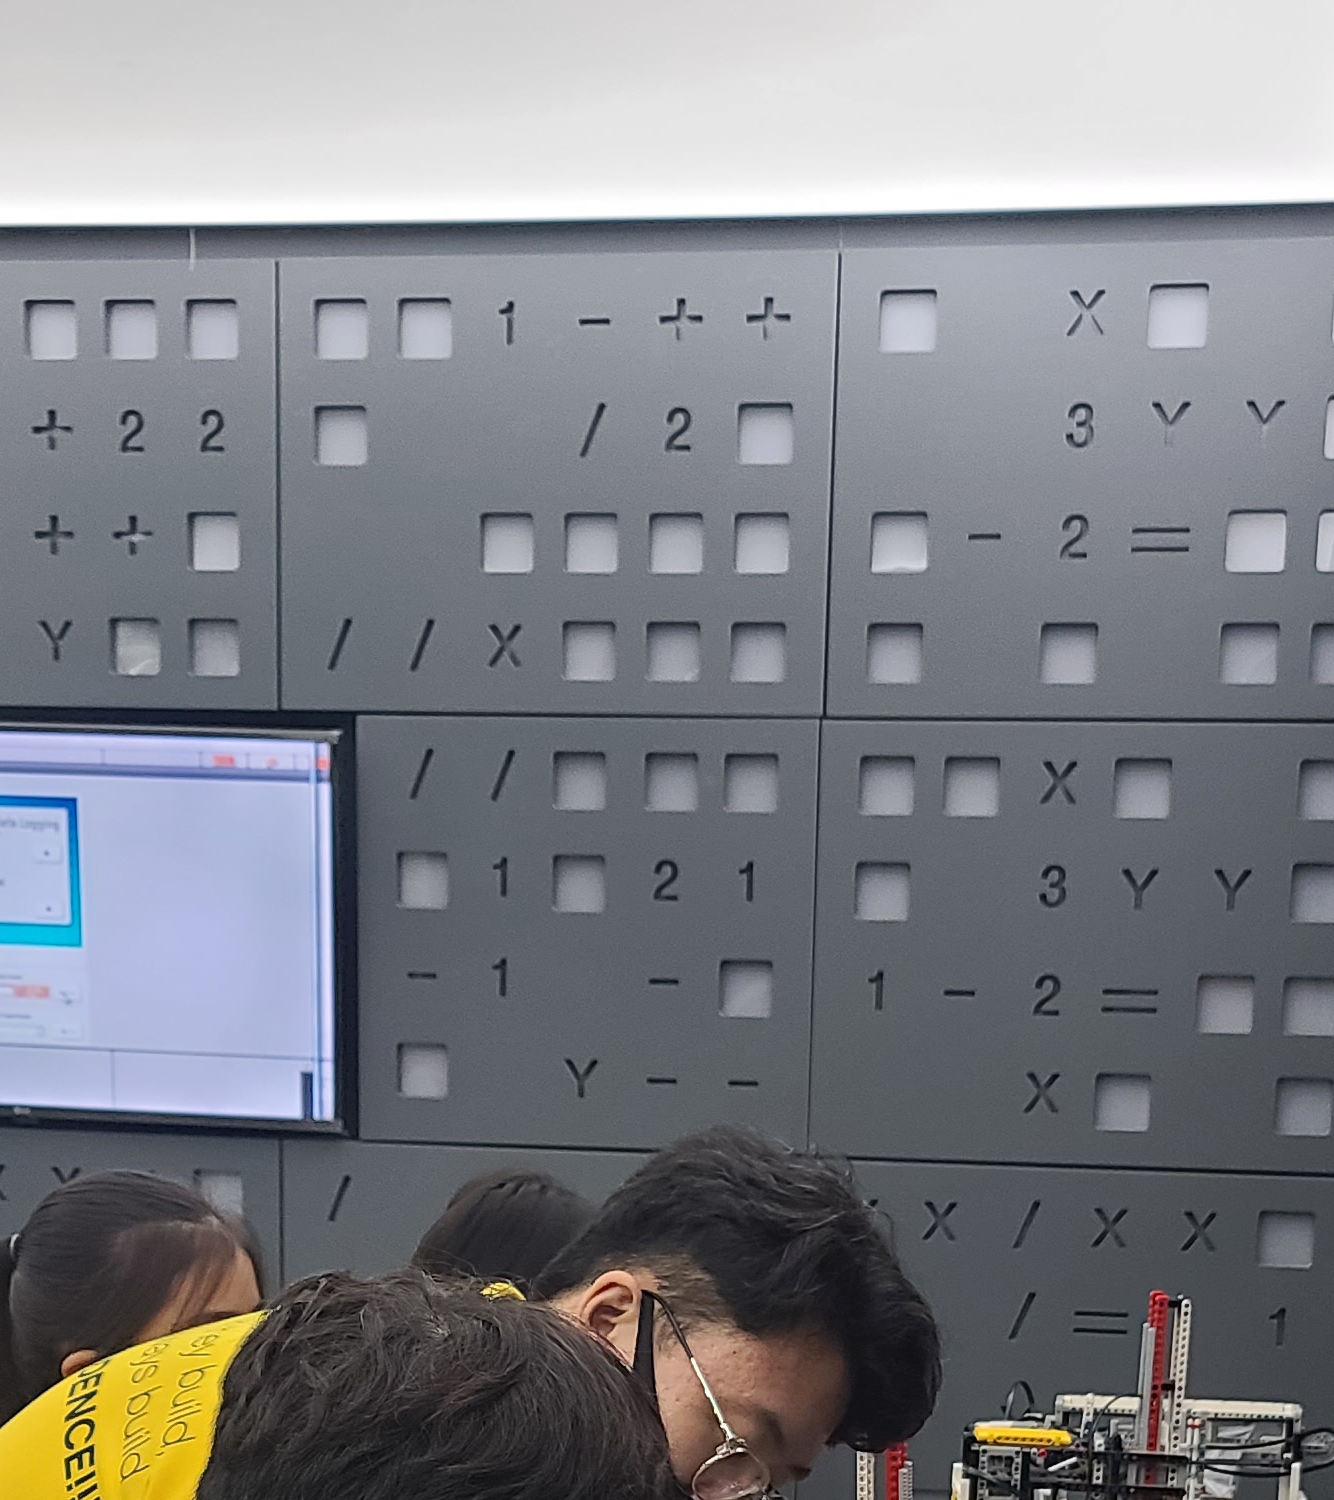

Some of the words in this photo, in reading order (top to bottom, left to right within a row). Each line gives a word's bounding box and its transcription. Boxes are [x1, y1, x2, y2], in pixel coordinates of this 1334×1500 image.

[499, 301, 514, 345] 1
[1067, 290, 1105, 336] X
[121, 410, 144, 452] 2
[201, 409, 224, 452] 2
[666, 407, 691, 451] 2
[1066, 403, 1093, 448] 3
[1152, 401, 1191, 448] Y
[1247, 400, 1286, 446] Y
[1060, 514, 1088, 558] 2
[39, 621, 72, 661] Y
[489, 624, 521, 667] X
[1041, 761, 1077, 804] X
[493, 857, 508, 897] 1
[654, 859, 678, 901] 2
[739, 861, 754, 902] 1
[1039, 865, 1066, 908] 3
[1122, 869, 1158, 908] Y
[1215, 869, 1252, 909] Y
[492, 958, 507, 997] 1
[868, 970, 884, 1010] 1
[1033, 974, 1061, 1016] 2
[565, 1059, 598, 1098] Y
[1024, 1072, 1060, 1113] X
[923, 1201, 957, 1240] X
[1092, 1208, 1128, 1247] X
[1181, 1211, 1216, 1251] X
